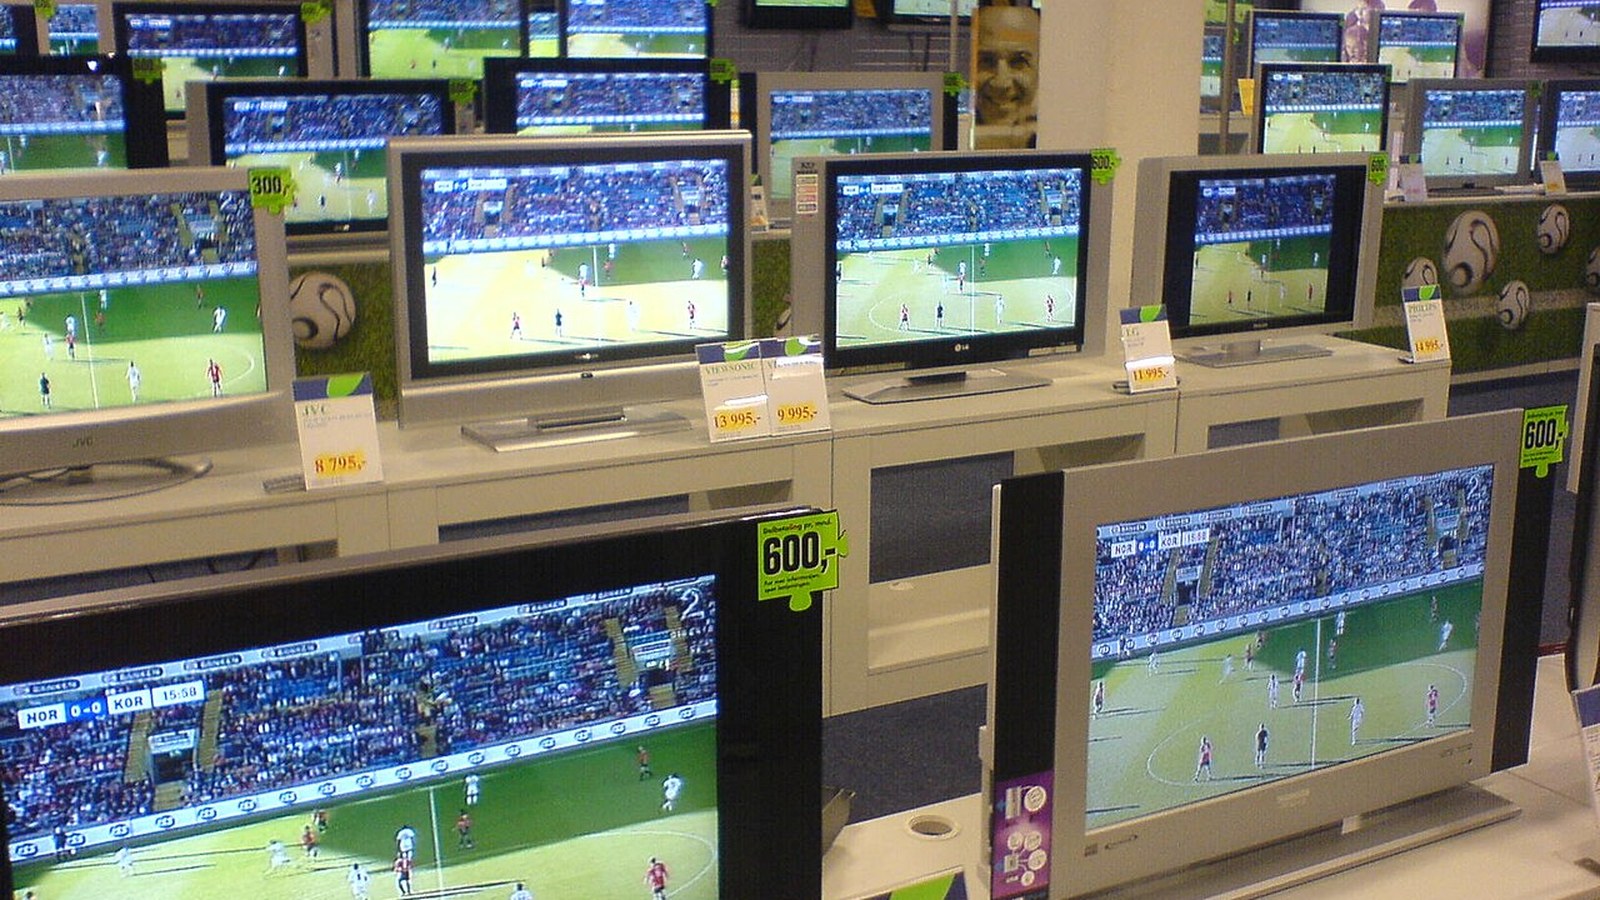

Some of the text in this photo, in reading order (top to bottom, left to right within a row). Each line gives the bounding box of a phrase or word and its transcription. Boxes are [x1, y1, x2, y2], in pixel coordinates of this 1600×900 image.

[714, 411, 762, 429] 13 995,-
[777, 406, 818, 421] 9 995,-
[1525, 418, 1563, 450] 600,-
[329, 455, 366, 471] 795,-
[763, 531, 836, 575] 600,-
[27, 687, 197, 724] NOR 0-0 KOR 15:58
